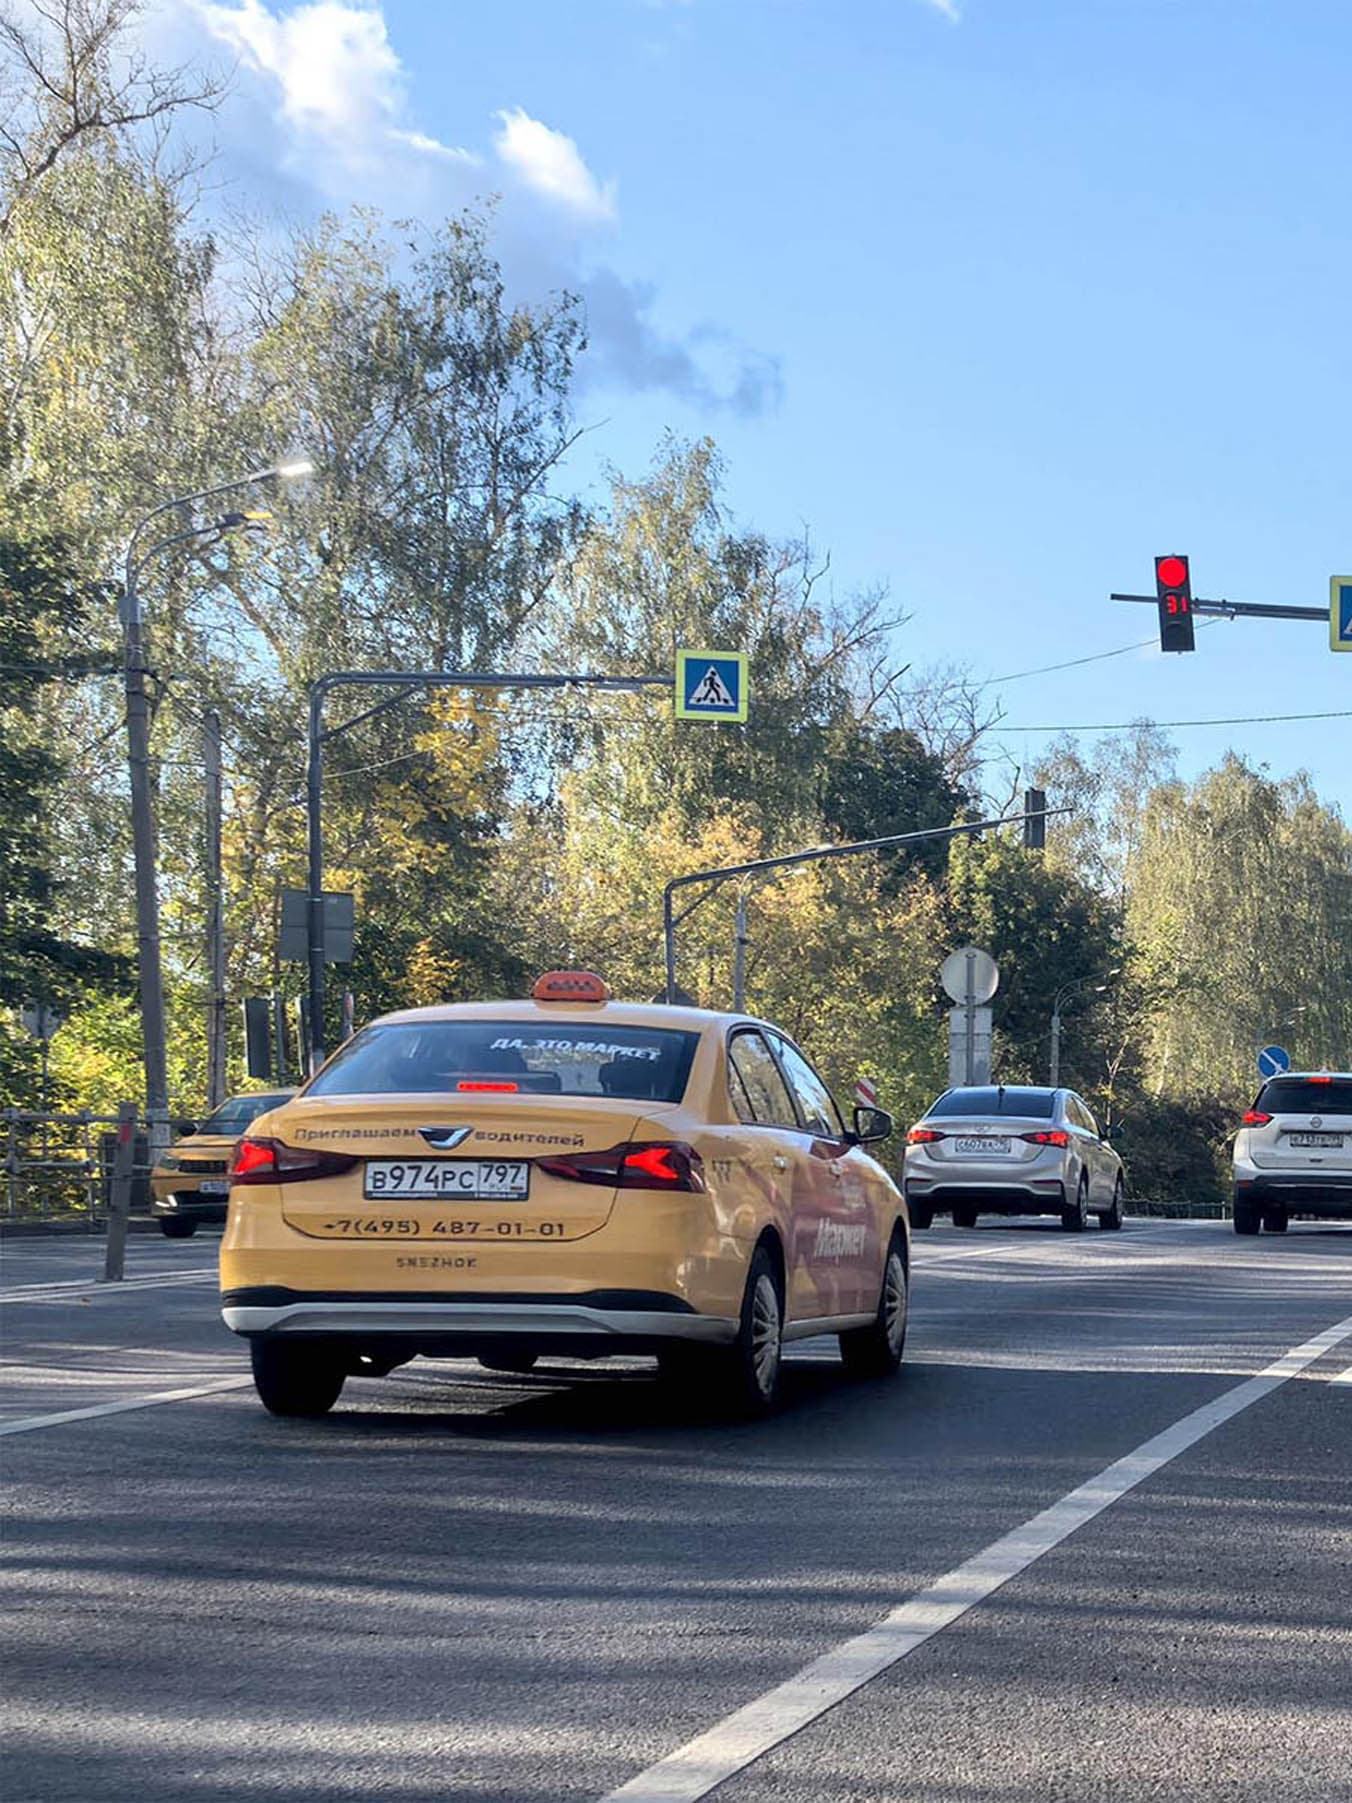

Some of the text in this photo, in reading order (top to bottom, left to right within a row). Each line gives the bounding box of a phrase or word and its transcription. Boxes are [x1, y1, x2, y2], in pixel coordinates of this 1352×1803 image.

[1166, 595, 1189, 614] 31
[575, 1041, 662, 1060] МАРКЕТ
[294, 1128, 584, 1147] Приглашаем водителей
[373, 1164, 474, 1189] В974РС
[432, 1221, 565, 1236] 487-01-01
